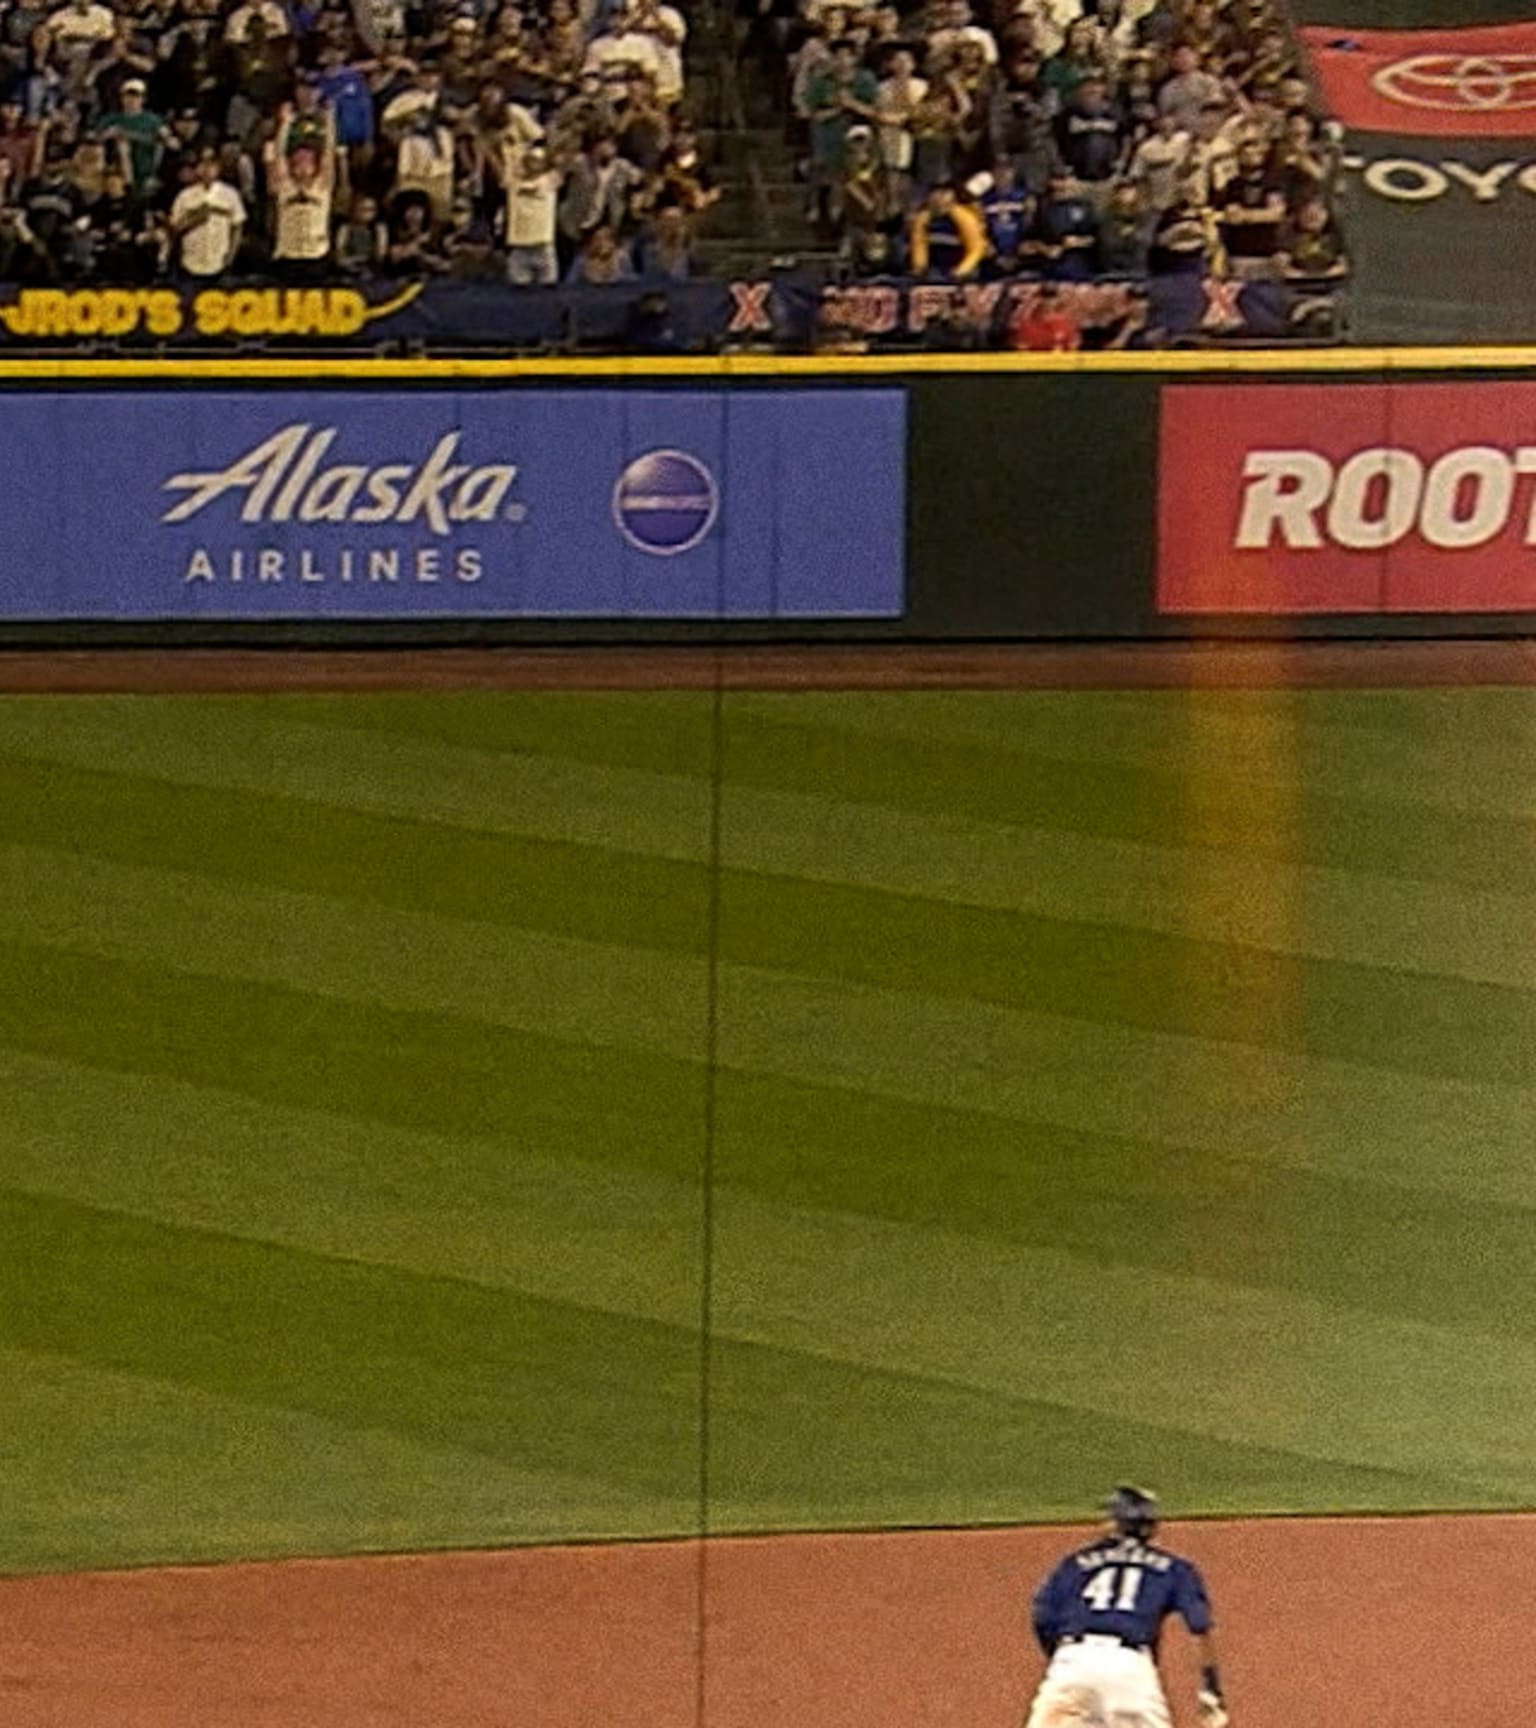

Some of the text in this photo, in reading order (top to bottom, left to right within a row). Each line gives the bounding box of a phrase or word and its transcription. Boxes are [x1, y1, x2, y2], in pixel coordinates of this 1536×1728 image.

[1340, 156, 1536, 199] OY
[4, 289, 367, 335] JROD'S SQUAD
[728, 282, 773, 332] X
[1201, 279, 1246, 327] X
[162, 423, 518, 535] Alaska
[184, 550, 483, 582] AIRLINES
[1081, 1566, 1144, 1612] 41
